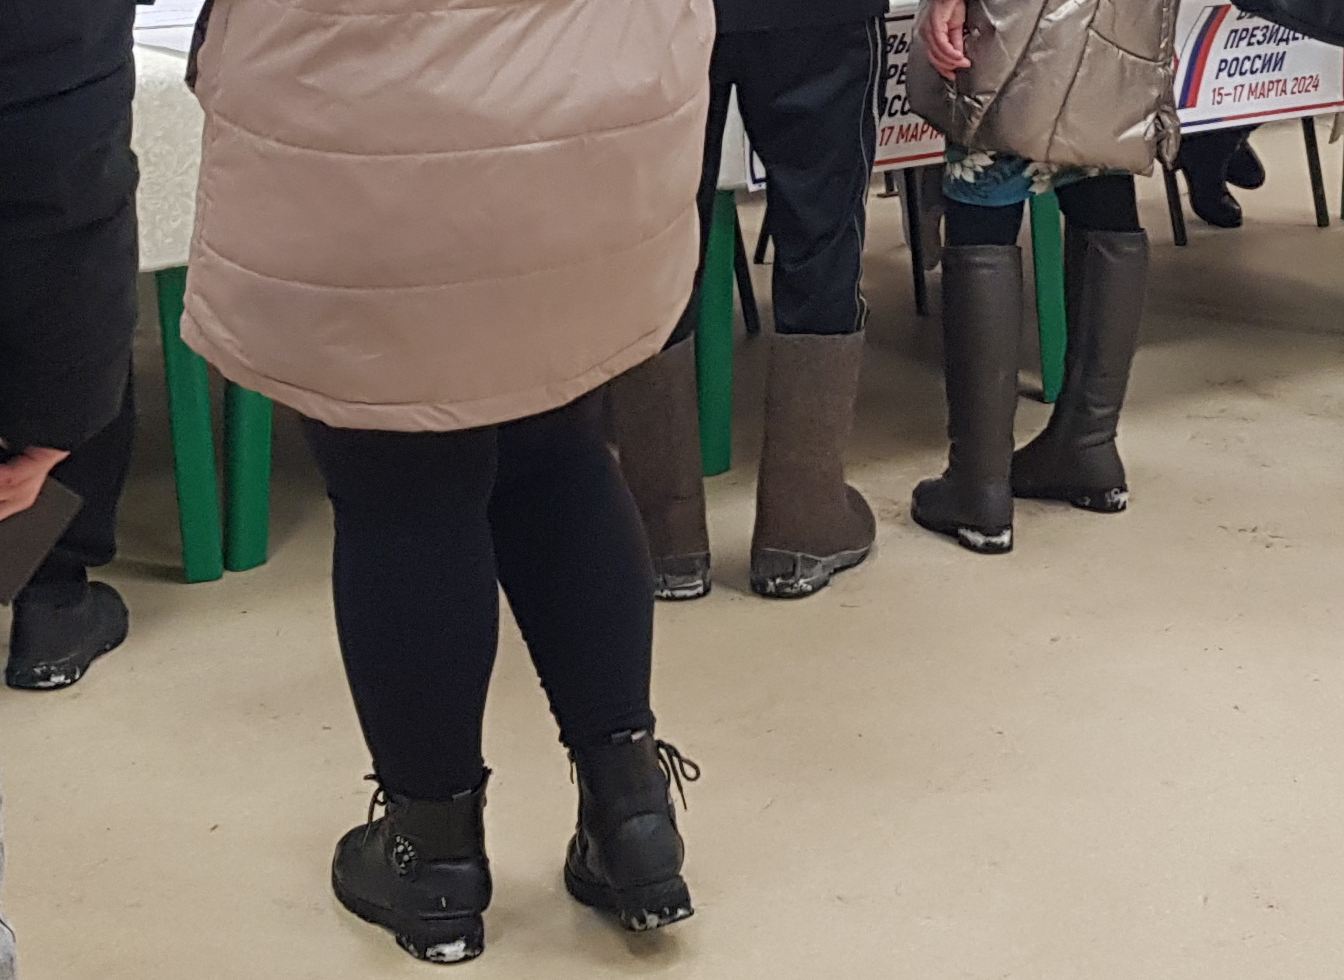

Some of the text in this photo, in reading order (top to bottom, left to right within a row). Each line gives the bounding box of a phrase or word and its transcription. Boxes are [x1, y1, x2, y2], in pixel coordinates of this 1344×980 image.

[1215, 51, 1287, 80] РОССИИ
[1247, 79, 1288, 101] МАРТА
[1291, 74, 1321, 95] 2024
